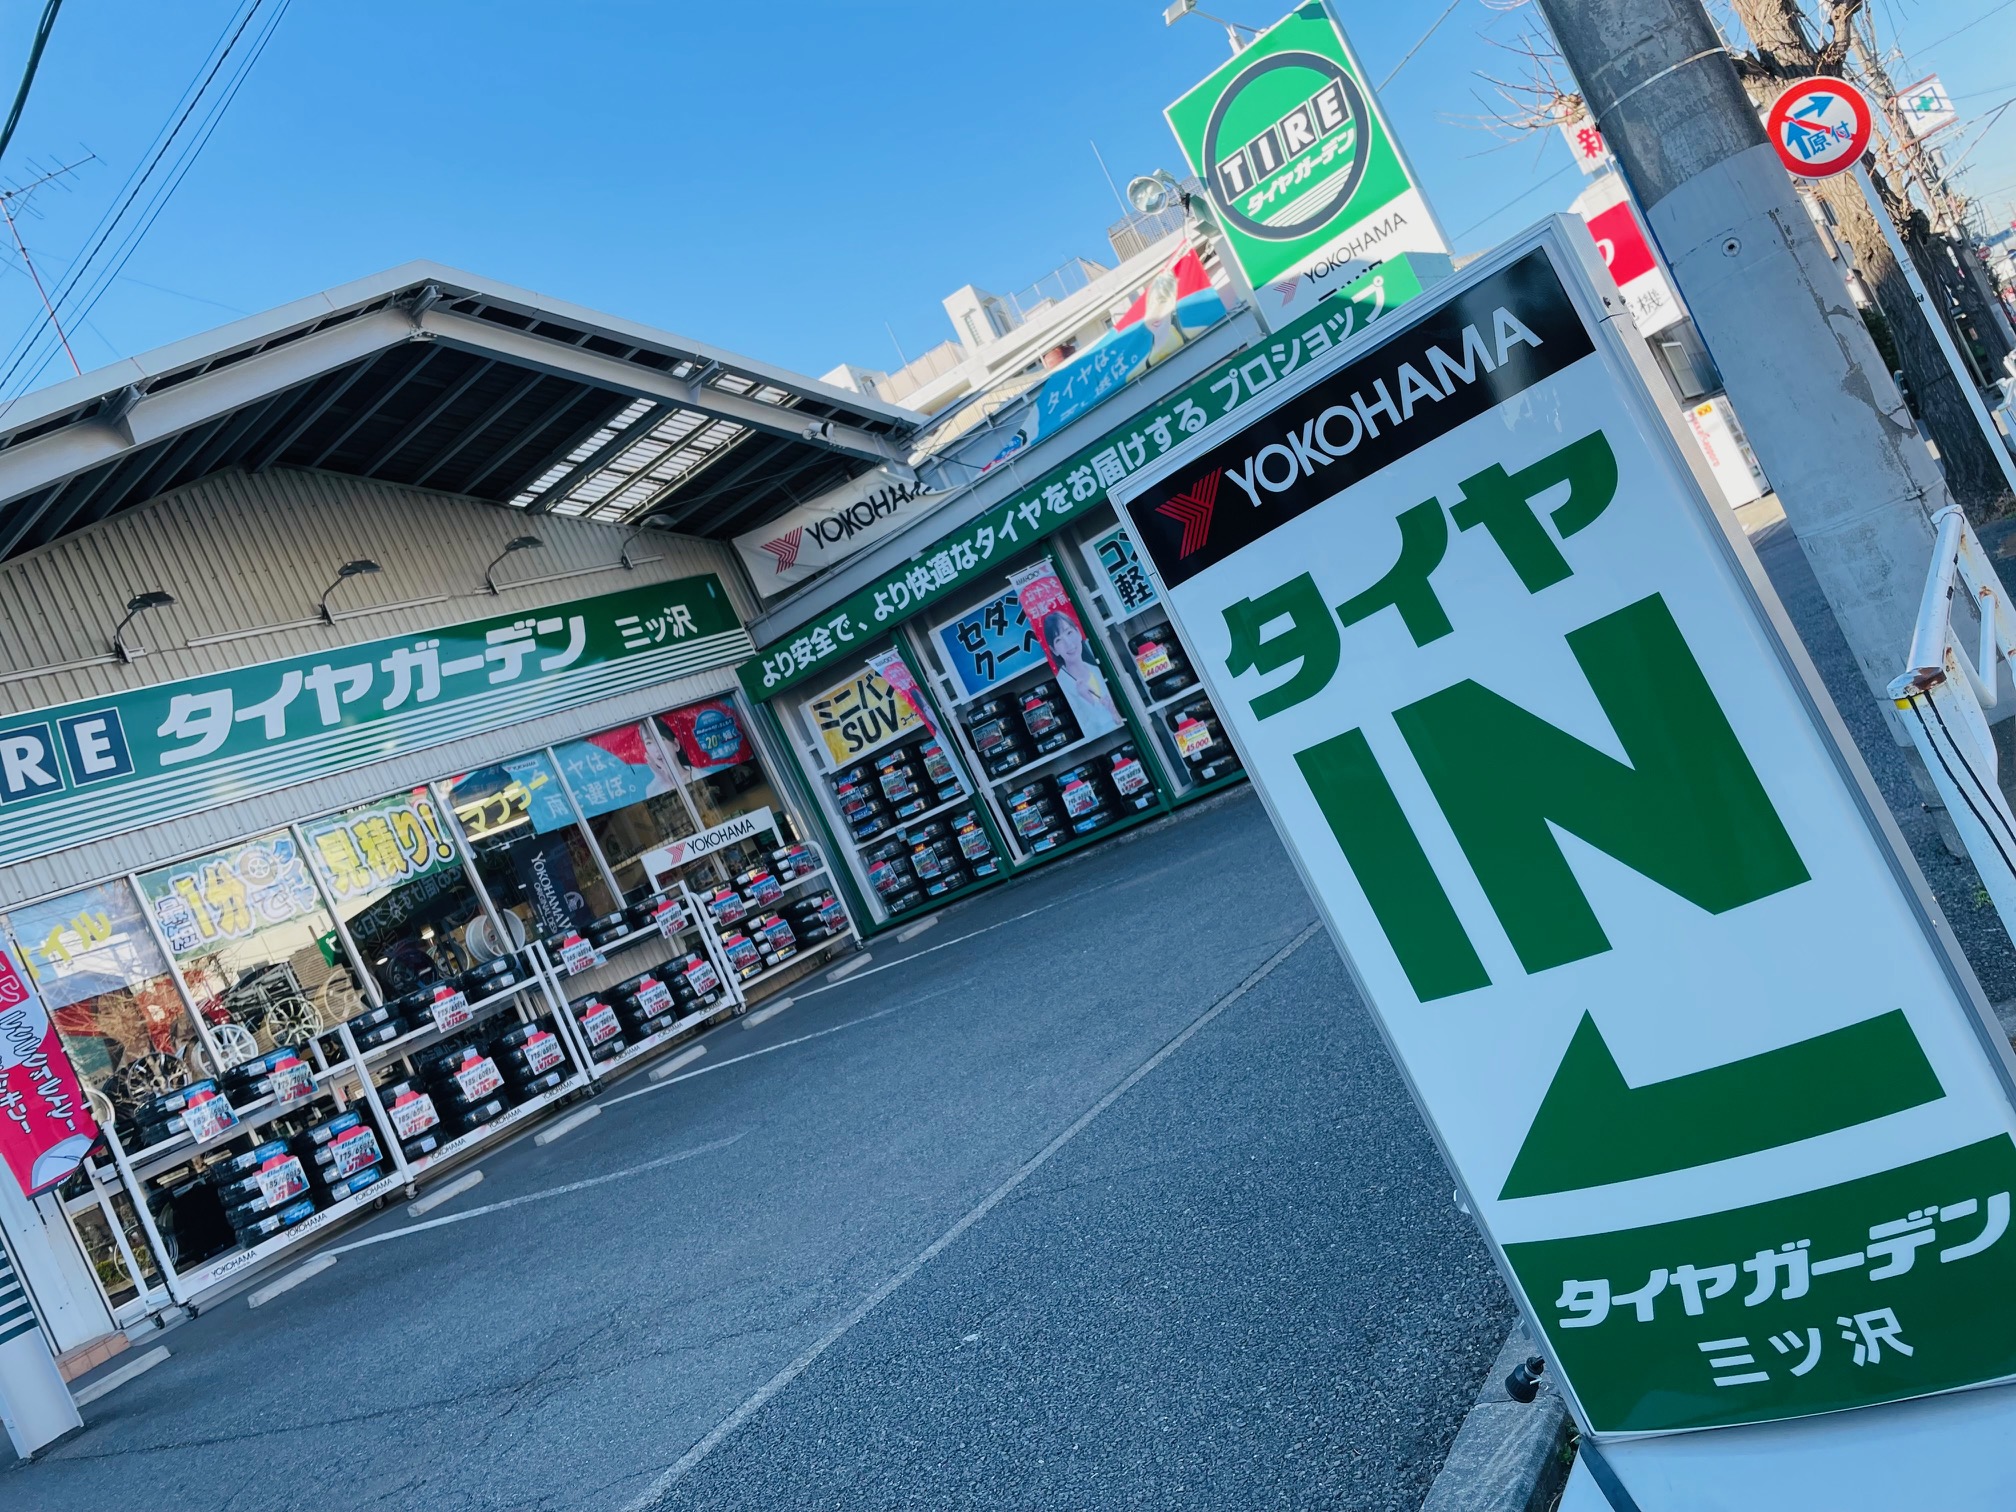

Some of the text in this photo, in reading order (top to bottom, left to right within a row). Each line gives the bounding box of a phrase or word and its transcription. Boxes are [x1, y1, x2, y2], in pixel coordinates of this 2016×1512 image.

[1223, 85, 1342, 201] TIRE
[1247, 128, 1355, 216] タイヤガーデン
[1807, 120, 1853, 155] 原付
[1303, 212, 1408, 284] YOKOHAMA
[1210, 275, 1385, 412] プロショップ
[1225, 305, 1544, 508] YOKOHAMA
[805, 480, 936, 550] YOKOHA
[1114, 566, 1154, 608] 軽
[1221, 428, 1619, 722] タイヤ
[157, 615, 587, 766] タイヤガーデン
[842, 700, 899, 753] SUV
[0, 718, 117, 792] RE
[531, 751, 616, 798] タヤは、
[458, 775, 549, 832] マフラー
[1293, 591, 1812, 1003] IN
[316, 803, 454, 895] 見積り!
[687, 818, 756, 855] YOKOHAMA
[531, 850, 564, 923] YOKOHAMA
[430, 1138, 466, 1160] YOKOHAMA
[487, 1108, 522, 1130] YOKOHAMA
[285, 1212, 328, 1237] YOKOHAMA
[354, 1179, 393, 1202] YOKOHAMA
[211, 1250, 257, 1278] YOKOHAMA
[1555, 1191, 2011, 1329] タイヤガーデン
[1697, 1306, 1914, 1387] 三ツ沢
